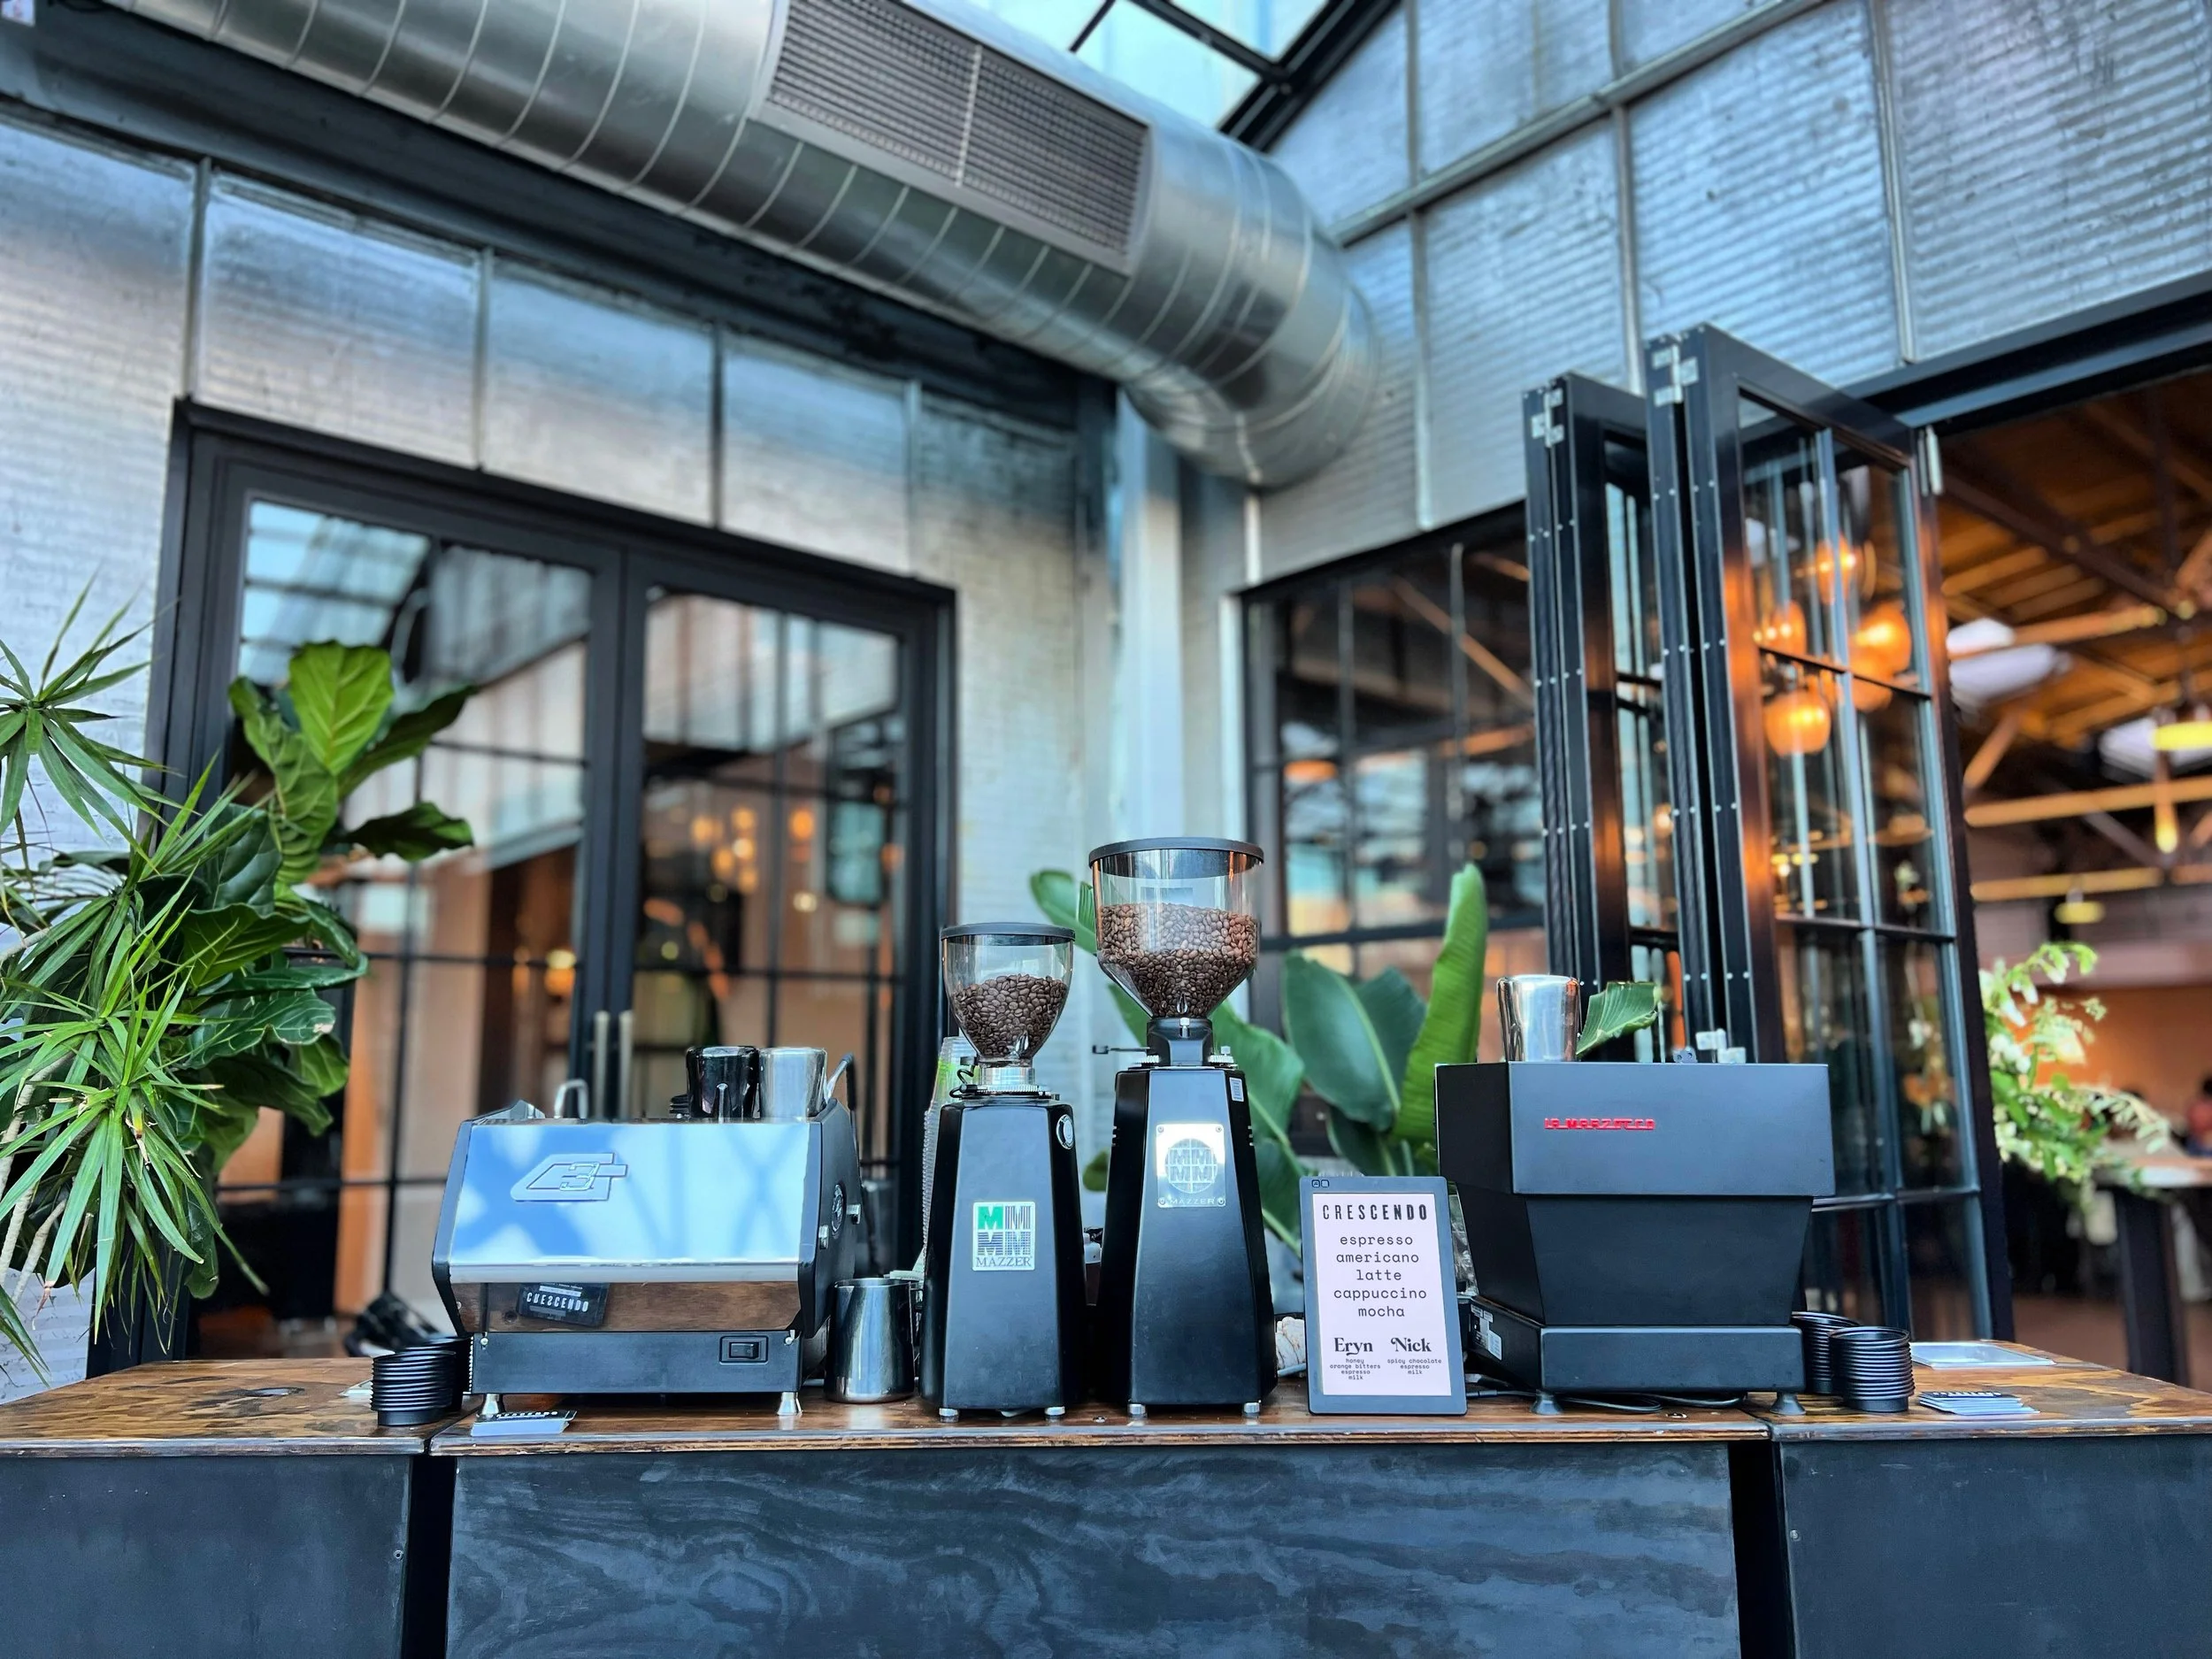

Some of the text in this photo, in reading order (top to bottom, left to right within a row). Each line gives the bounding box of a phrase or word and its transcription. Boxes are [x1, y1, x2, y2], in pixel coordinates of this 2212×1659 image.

[1322, 1204, 1428, 1220] CRESCENDO
[1340, 1235, 1414, 1247] espresso
[976, 1256, 1033, 1267] MAZZER
[1336, 1251, 1419, 1263] americano
[1356, 1269, 1402, 1280] latte
[1333, 1287, 1427, 1301] cappuccino
[1358, 1306, 1405, 1317] mocha
[1333, 1337, 1374, 1356] Eryn
[1390, 1337, 1432, 1352] Nick
